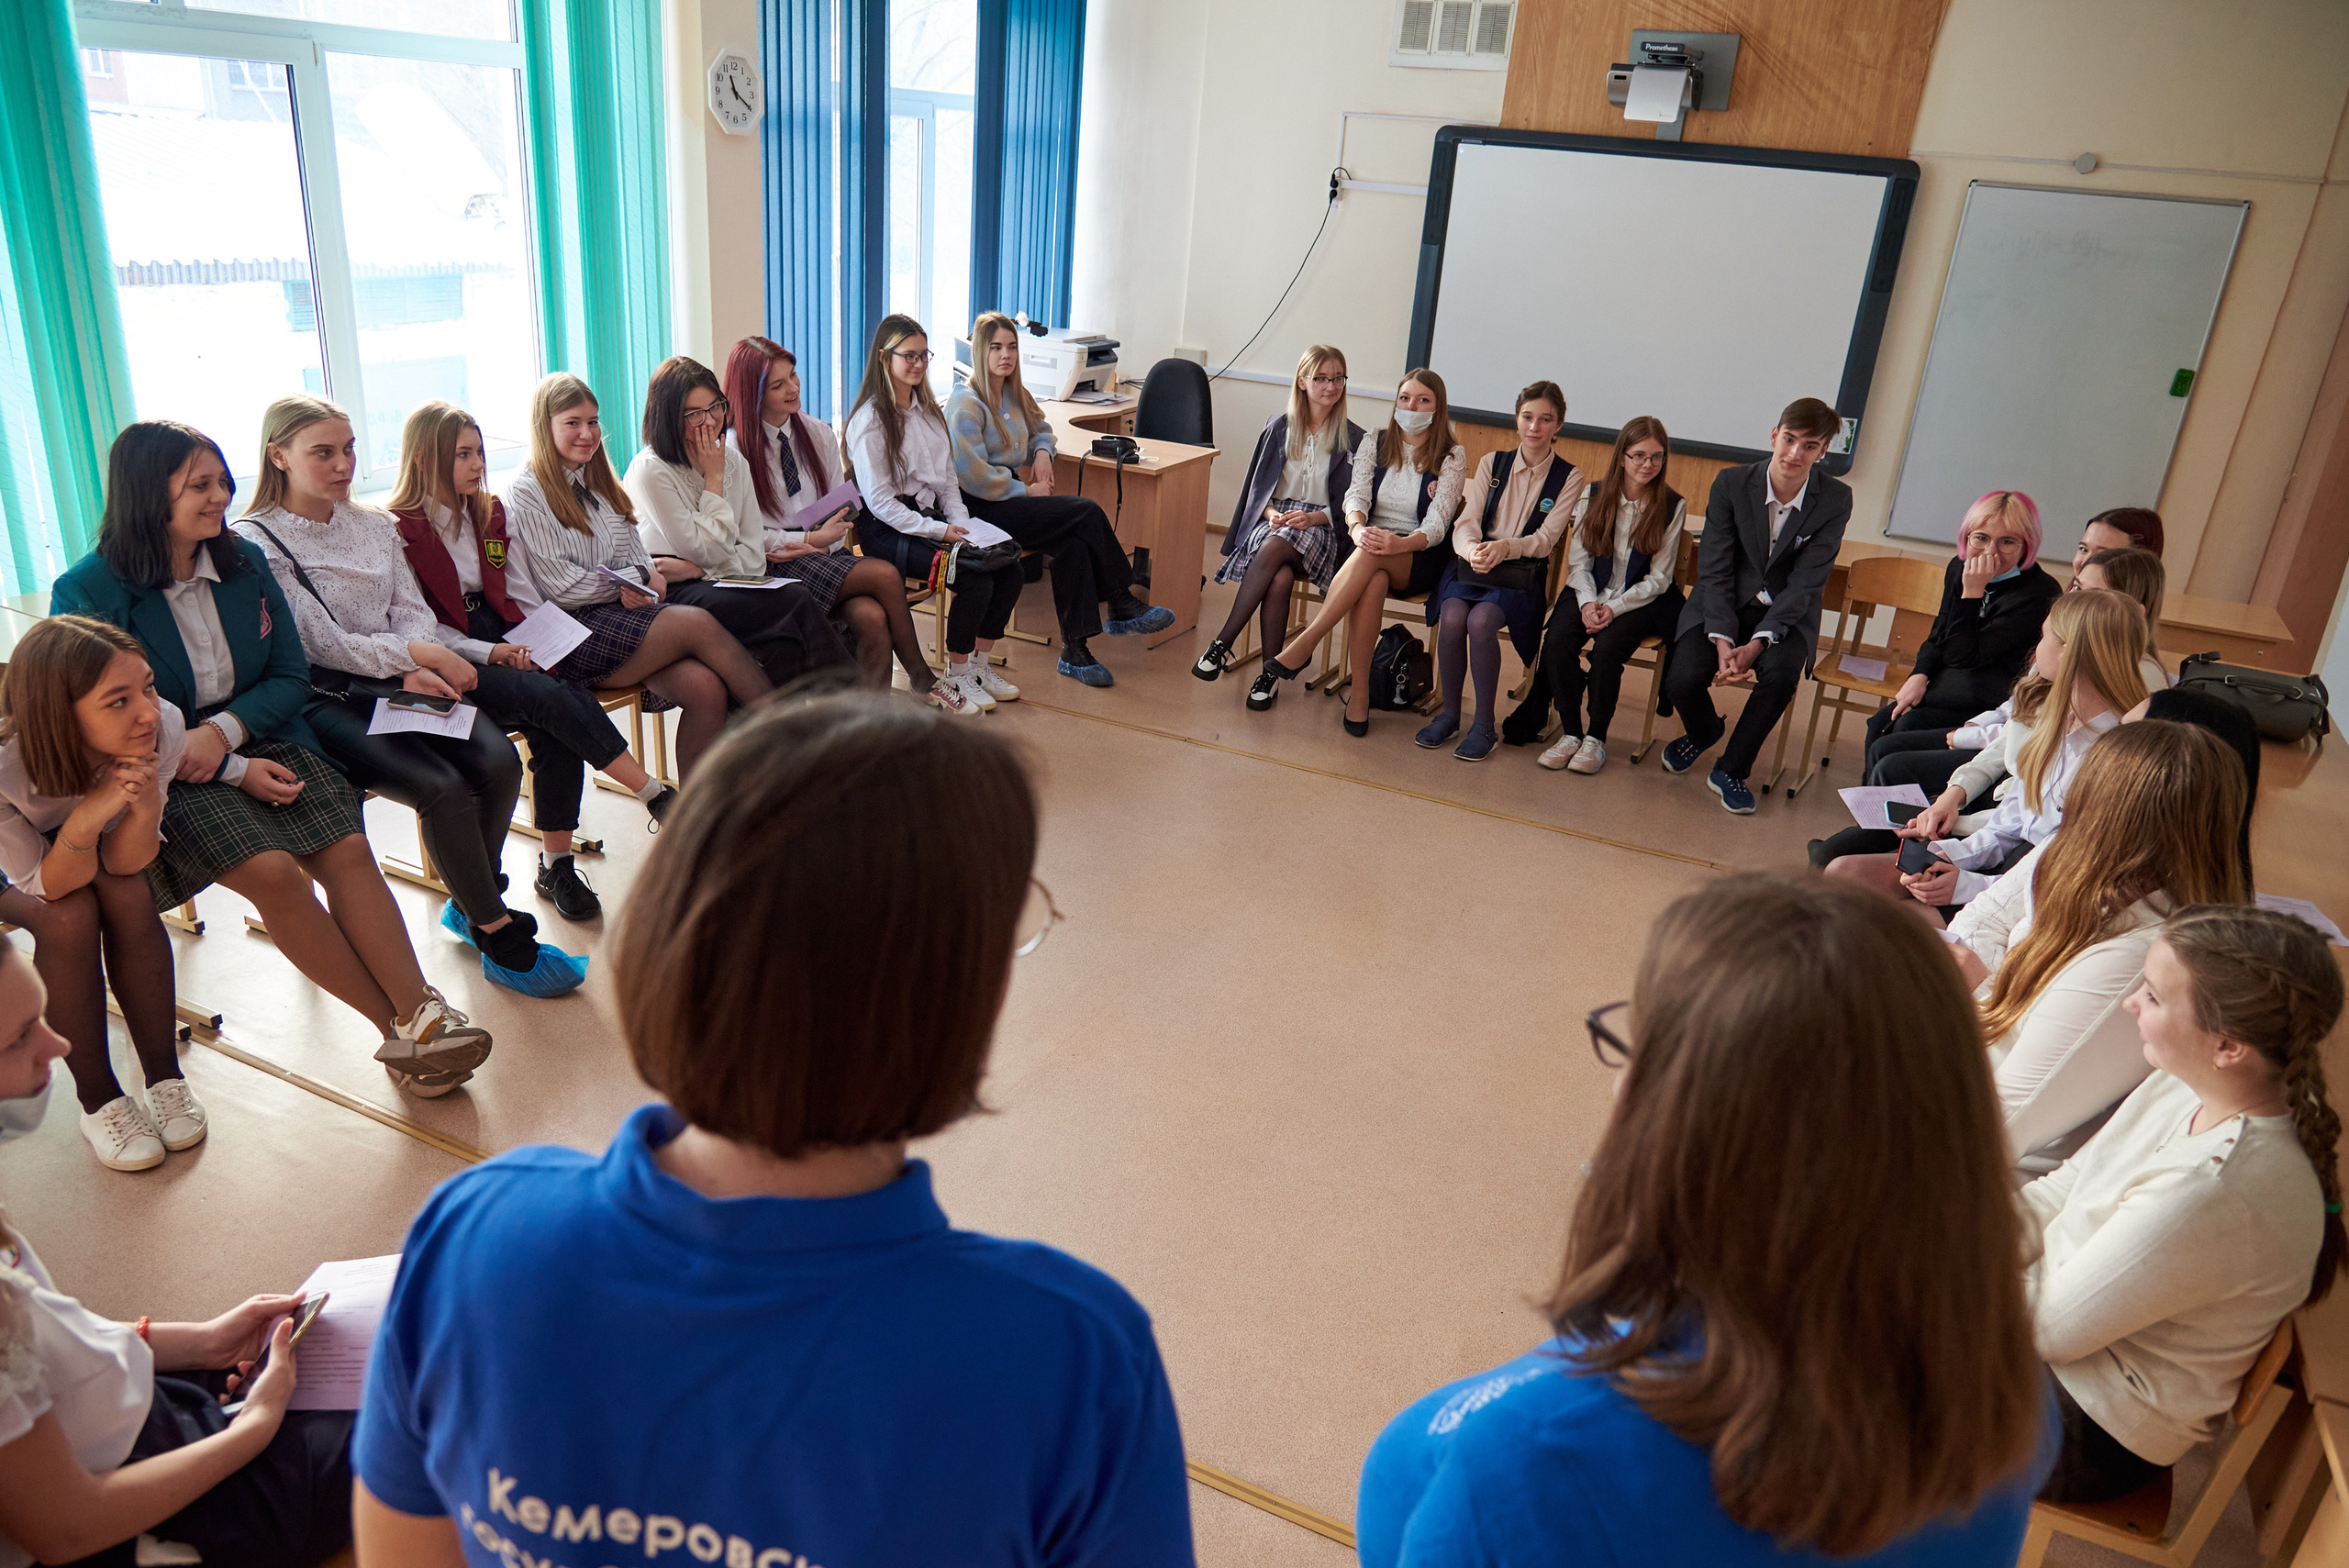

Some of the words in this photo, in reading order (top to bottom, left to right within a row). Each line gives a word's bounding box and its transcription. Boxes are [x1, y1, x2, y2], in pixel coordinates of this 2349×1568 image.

[1645, 43, 1678, 51] Promethean
[723, 63, 729, 72] 11
[730, 61, 738, 71] 12
[741, 67, 744, 75] 1
[717, 73, 723, 82] 10
[715, 86, 720, 95] 9
[749, 92, 754, 100] 3
[718, 100, 723, 108] 8
[725, 111, 729, 119] 7
[733, 116, 738, 124] 6
